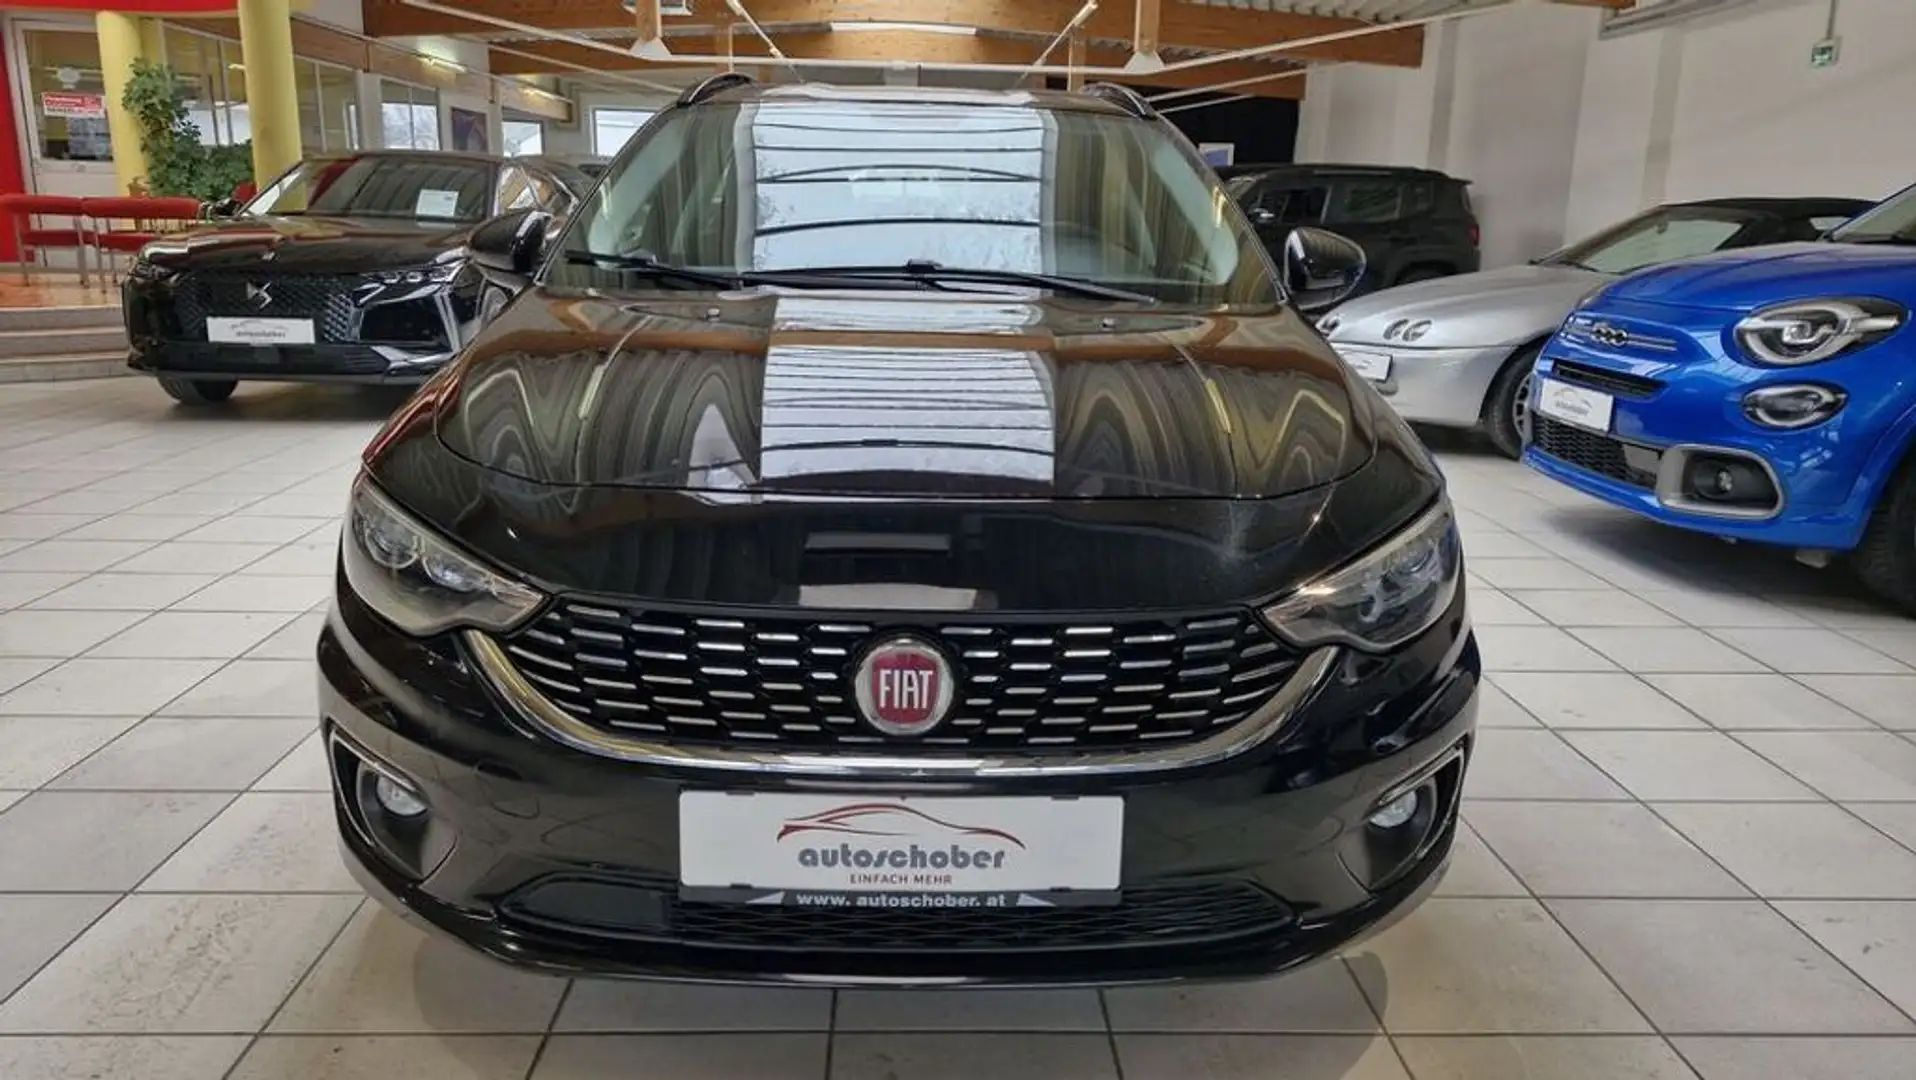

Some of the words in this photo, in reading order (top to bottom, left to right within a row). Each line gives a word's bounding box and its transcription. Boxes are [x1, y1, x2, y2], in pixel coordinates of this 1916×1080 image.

[880, 668, 933, 709] FIAT
[798, 843, 1005, 869] autoschober
[850, 873, 908, 885] EINFACH
[914, 874, 952, 886] MEHR
